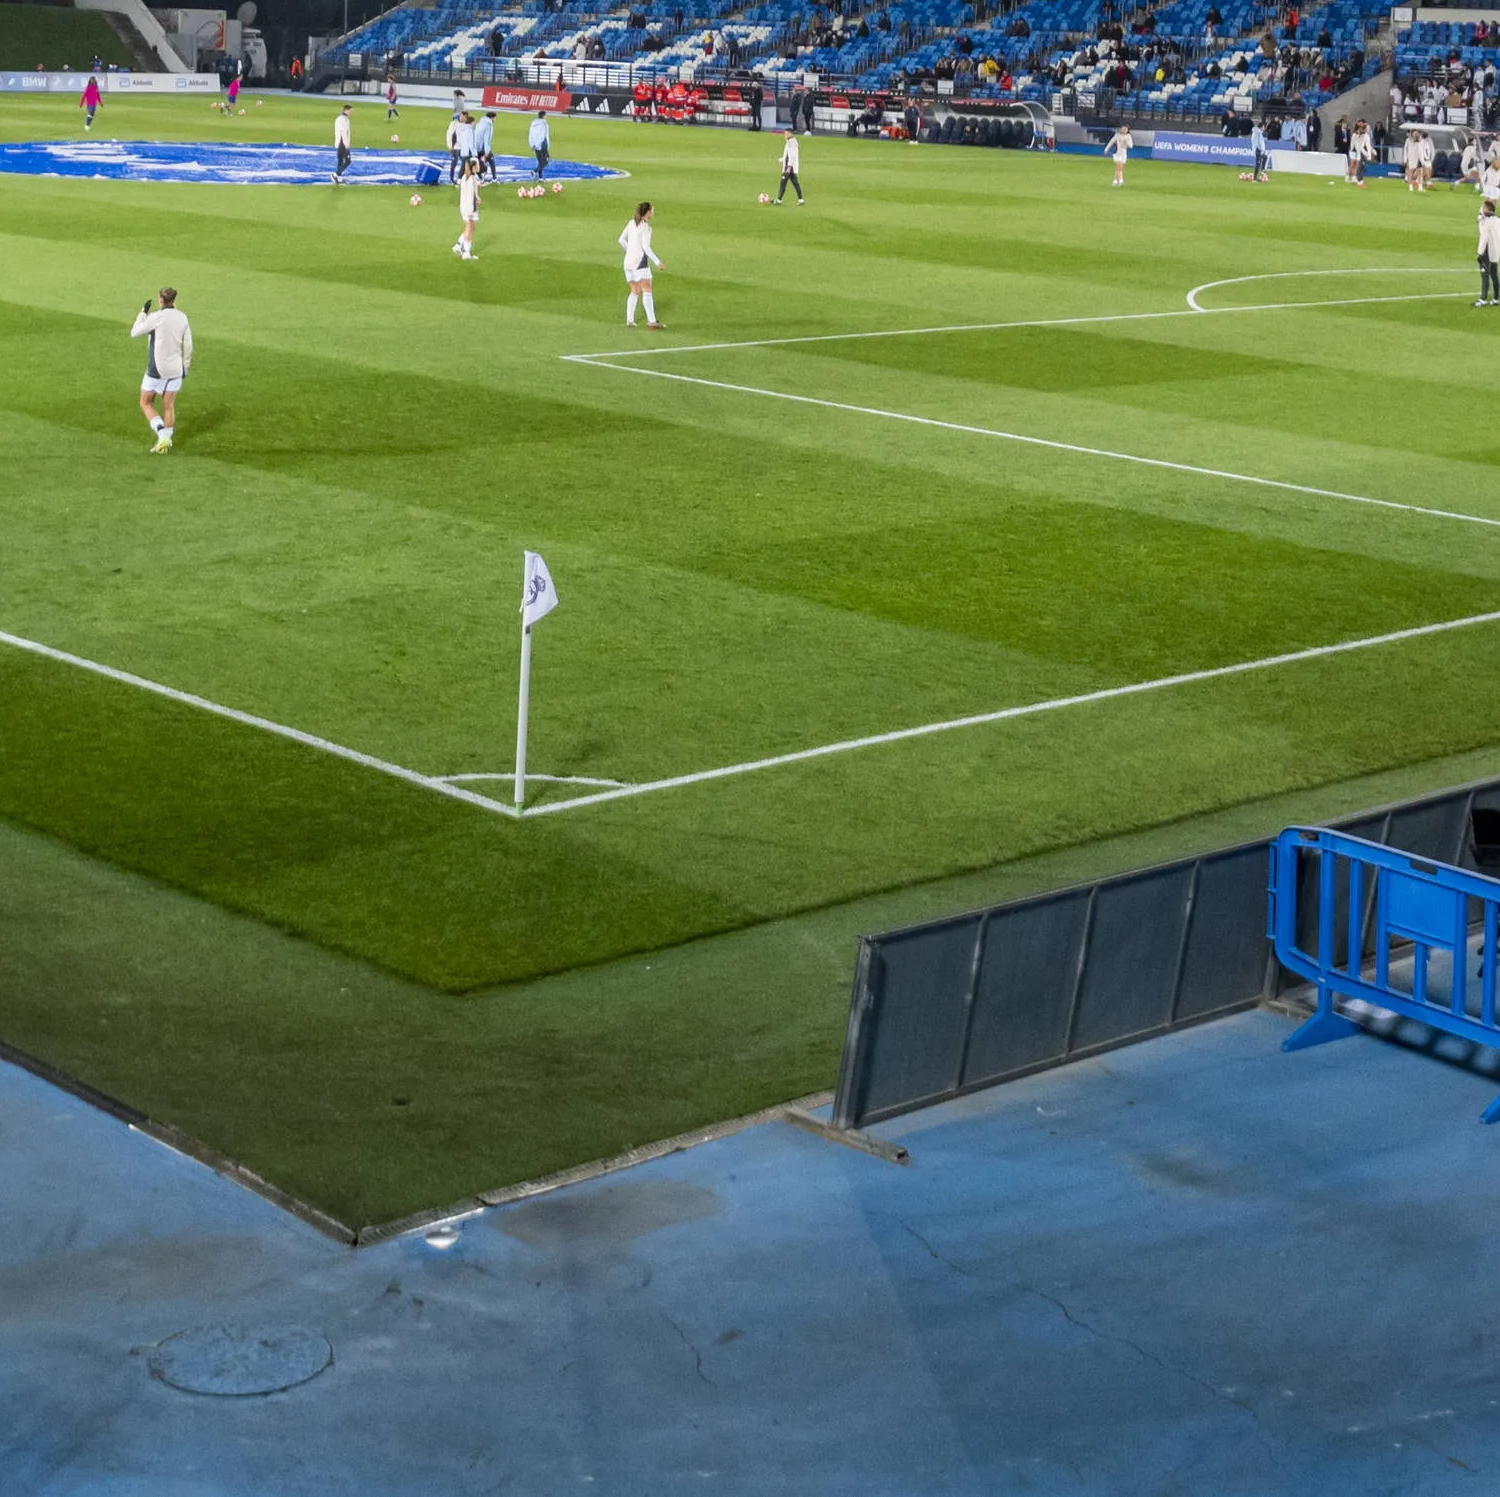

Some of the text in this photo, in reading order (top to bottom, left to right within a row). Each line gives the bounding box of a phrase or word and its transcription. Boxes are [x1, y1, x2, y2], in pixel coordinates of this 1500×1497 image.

[22, 78, 47, 87] BMW
[81, 78, 105, 88] BW
[495, 91, 558, 107] Emirates FLY BETTER
[1154, 141, 1172, 151] UEFA
[1174, 142, 1209, 153] WOMEN'S
[1210, 146, 1254, 157] CHAMPION
